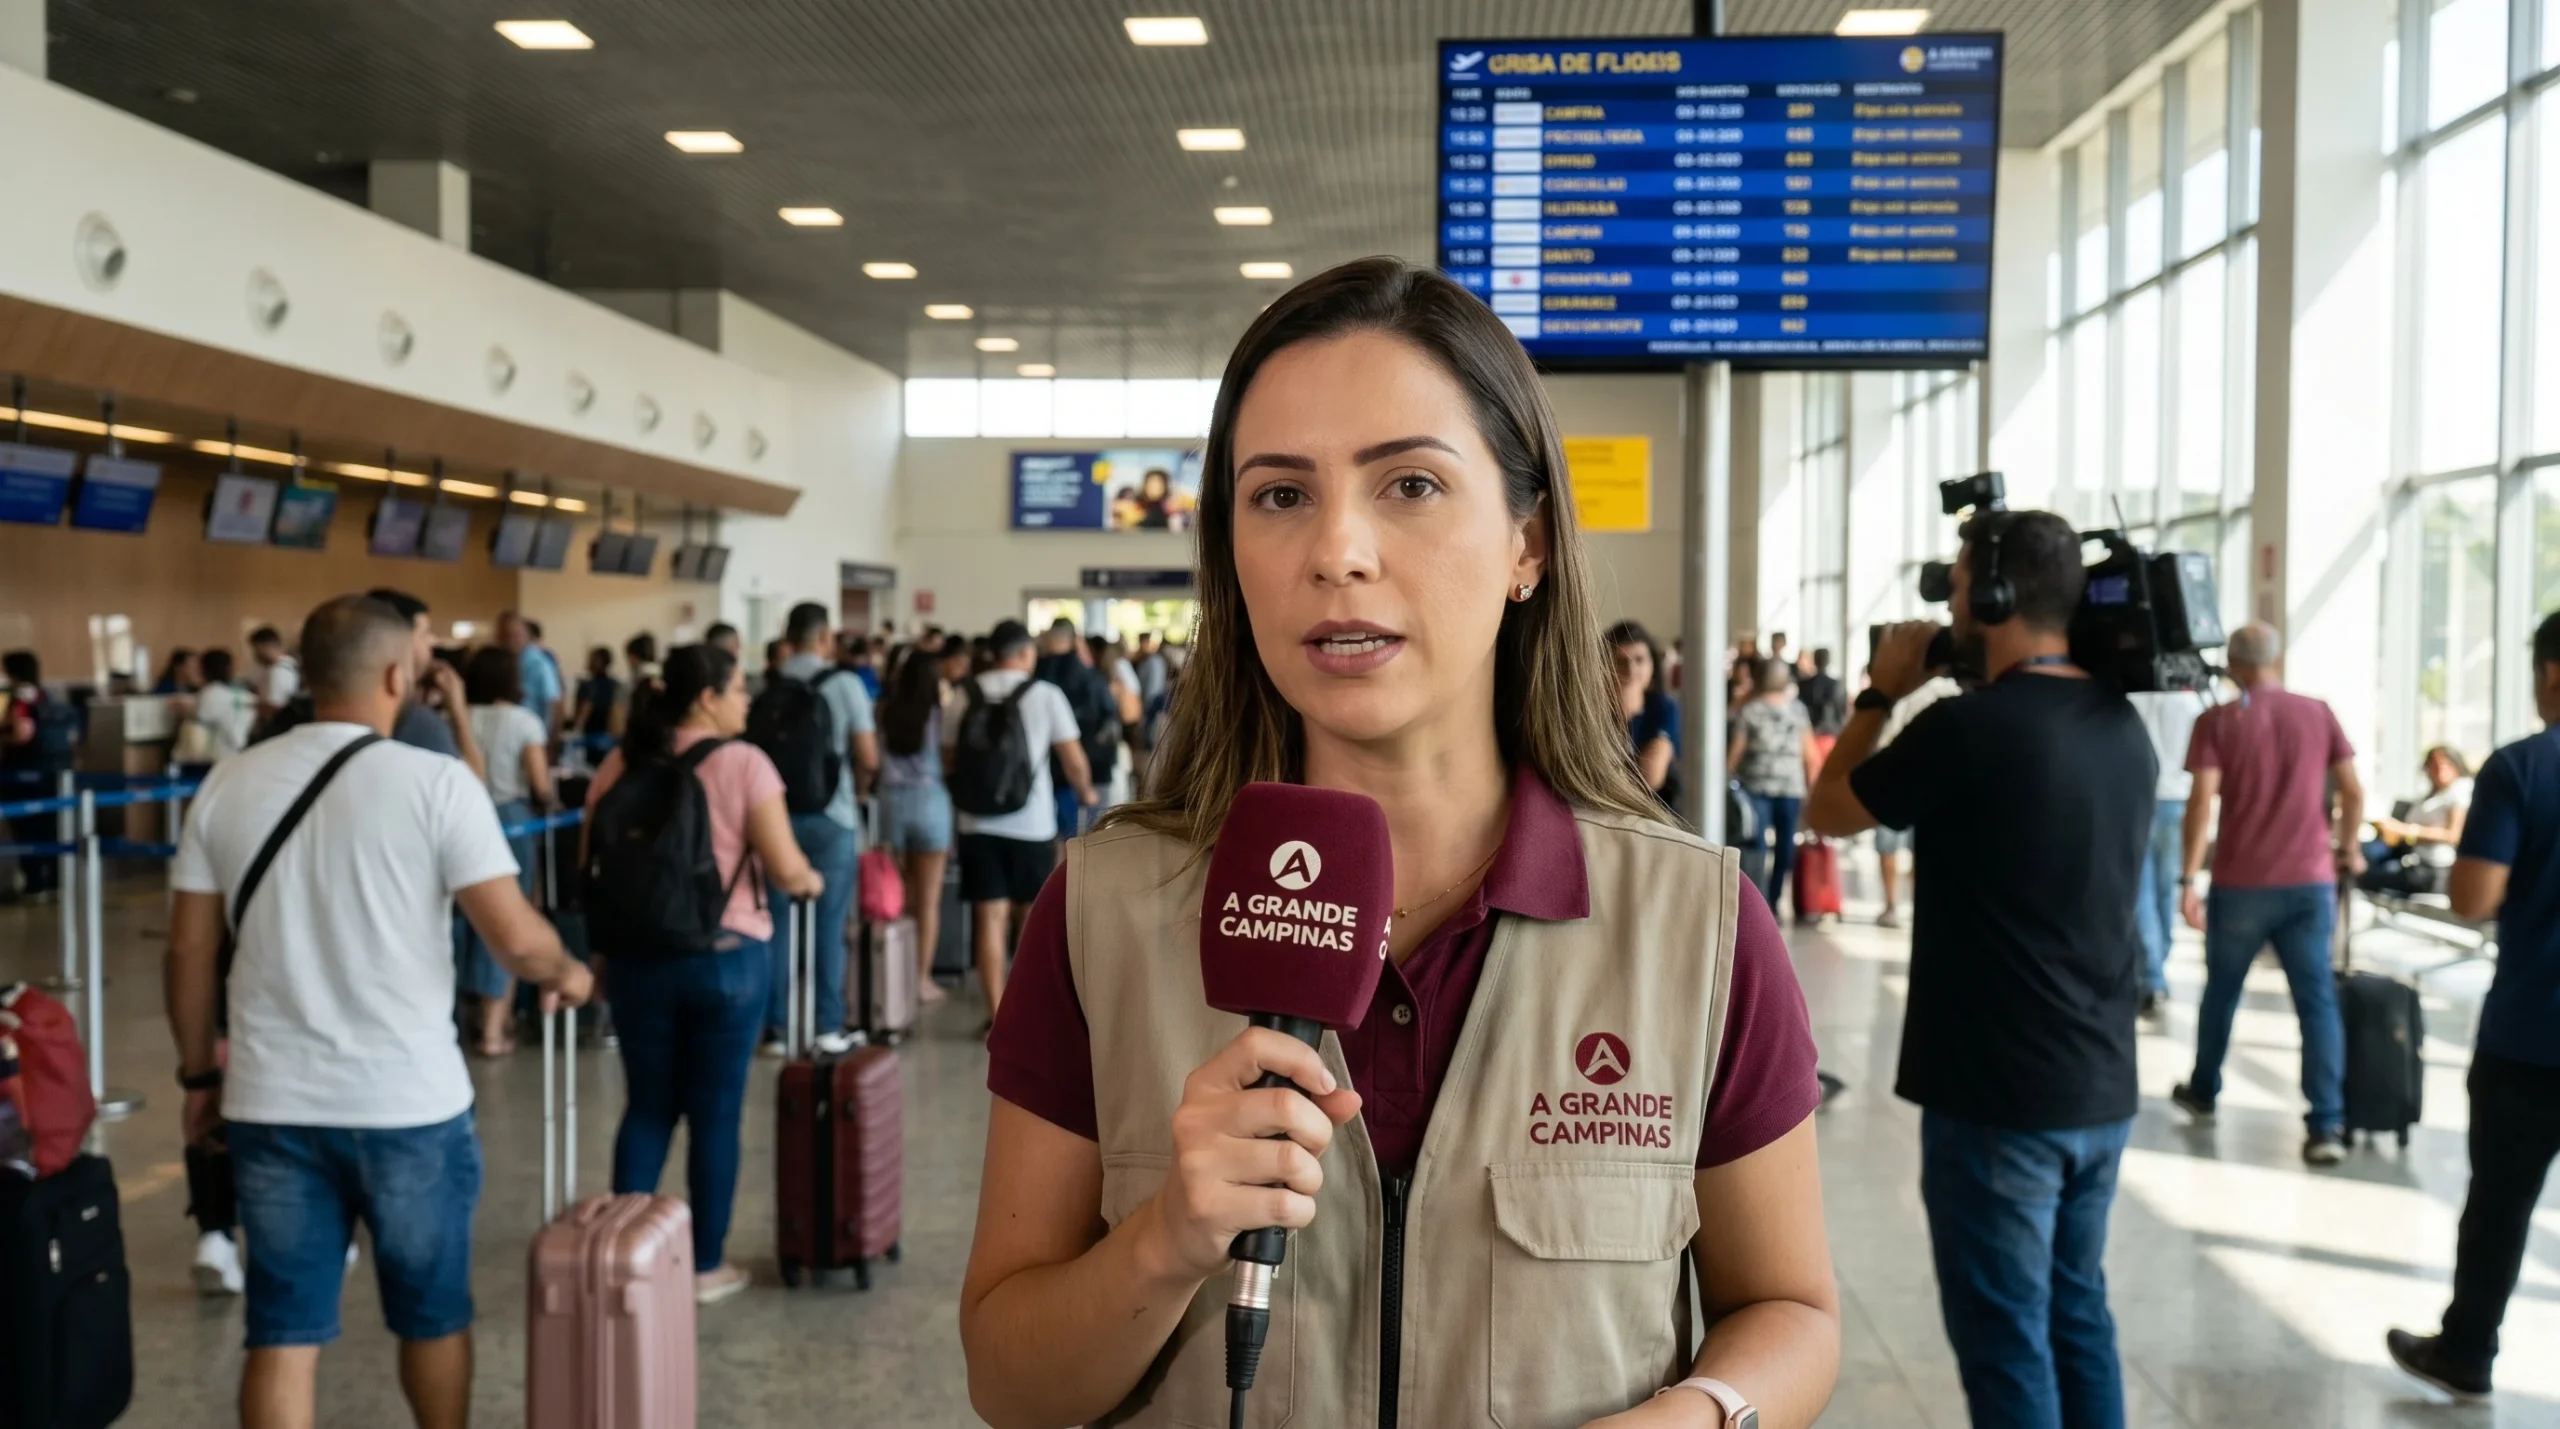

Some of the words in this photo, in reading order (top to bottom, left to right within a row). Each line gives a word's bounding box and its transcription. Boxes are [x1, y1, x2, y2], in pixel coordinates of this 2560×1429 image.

[1560, 53, 1592, 74] DE
[1223, 892, 1241, 912] A
[1247, 894, 1358, 927] GRANDE
[1219, 916, 1354, 952] CAMPINAS
[1529, 1092, 1552, 1116] A
[1559, 1092, 1673, 1119] GRANDE
[1529, 1121, 1671, 1149] CAMPINAS
